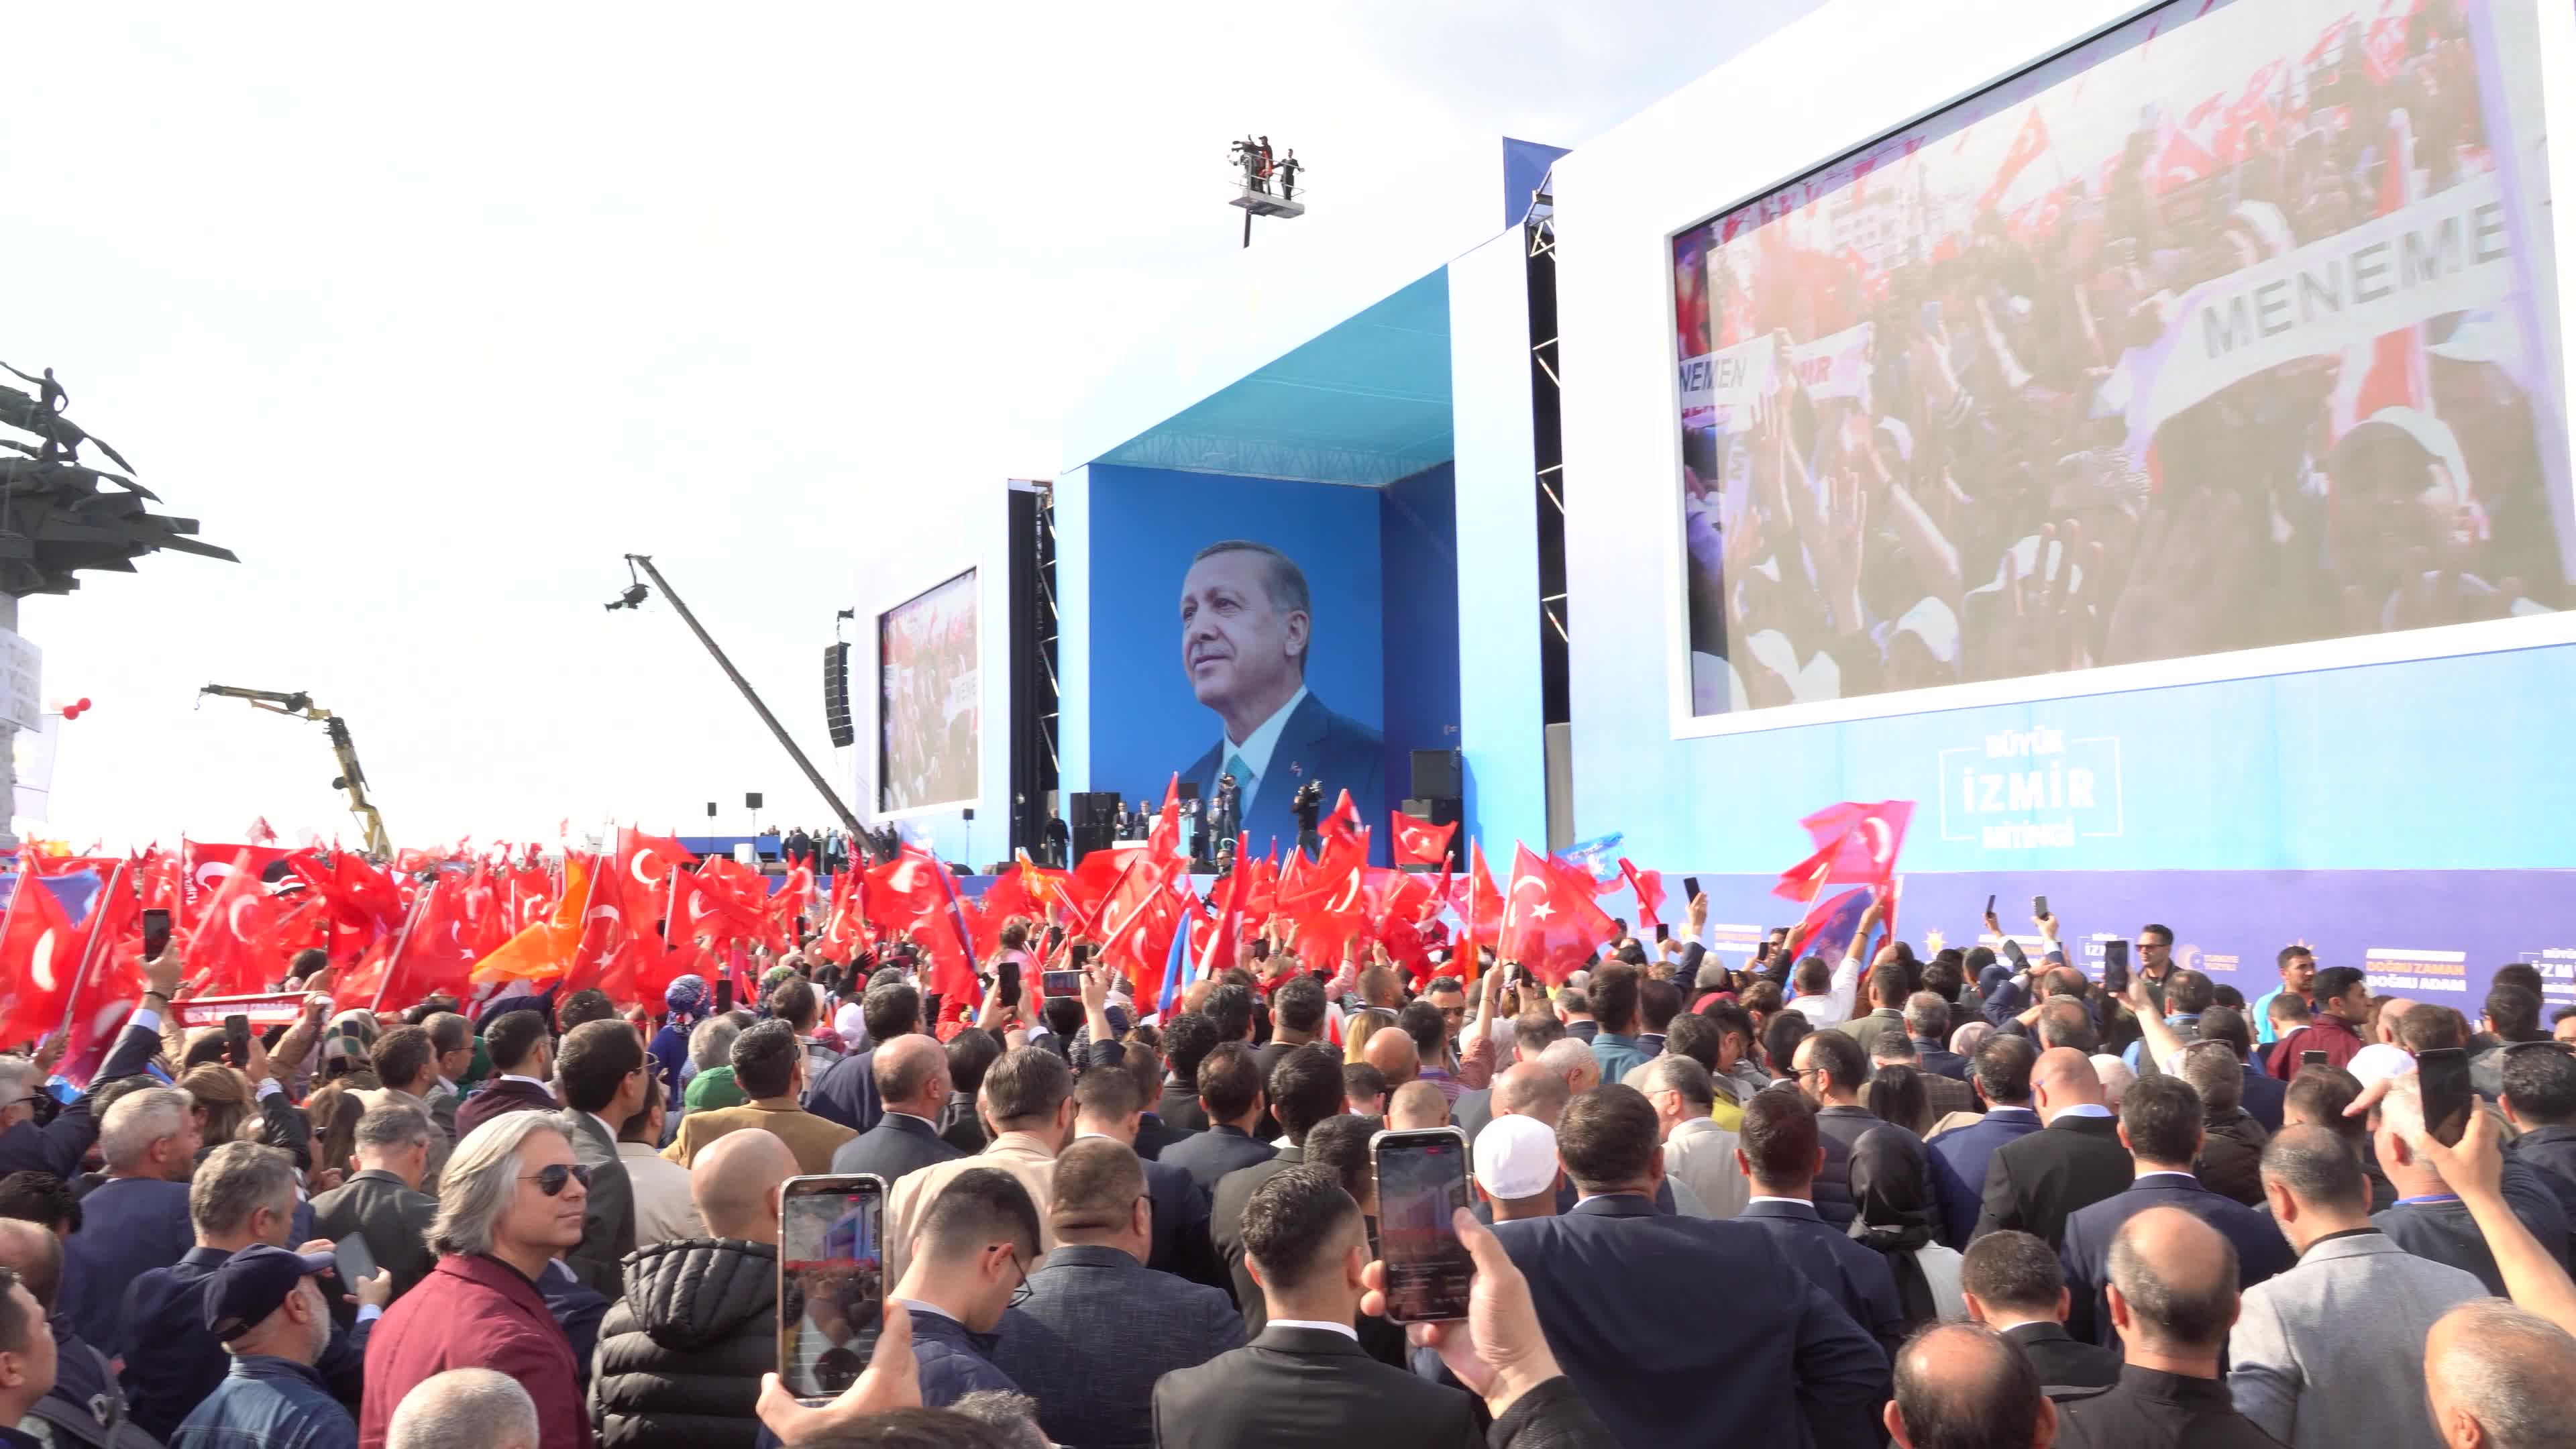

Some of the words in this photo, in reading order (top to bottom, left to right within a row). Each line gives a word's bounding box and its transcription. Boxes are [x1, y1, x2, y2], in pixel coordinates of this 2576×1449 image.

[1962, 760, 2096, 814] İZMİR
[2367, 974, 2418, 989] DOĞRU
[2419, 977, 2467, 991] ADAM
